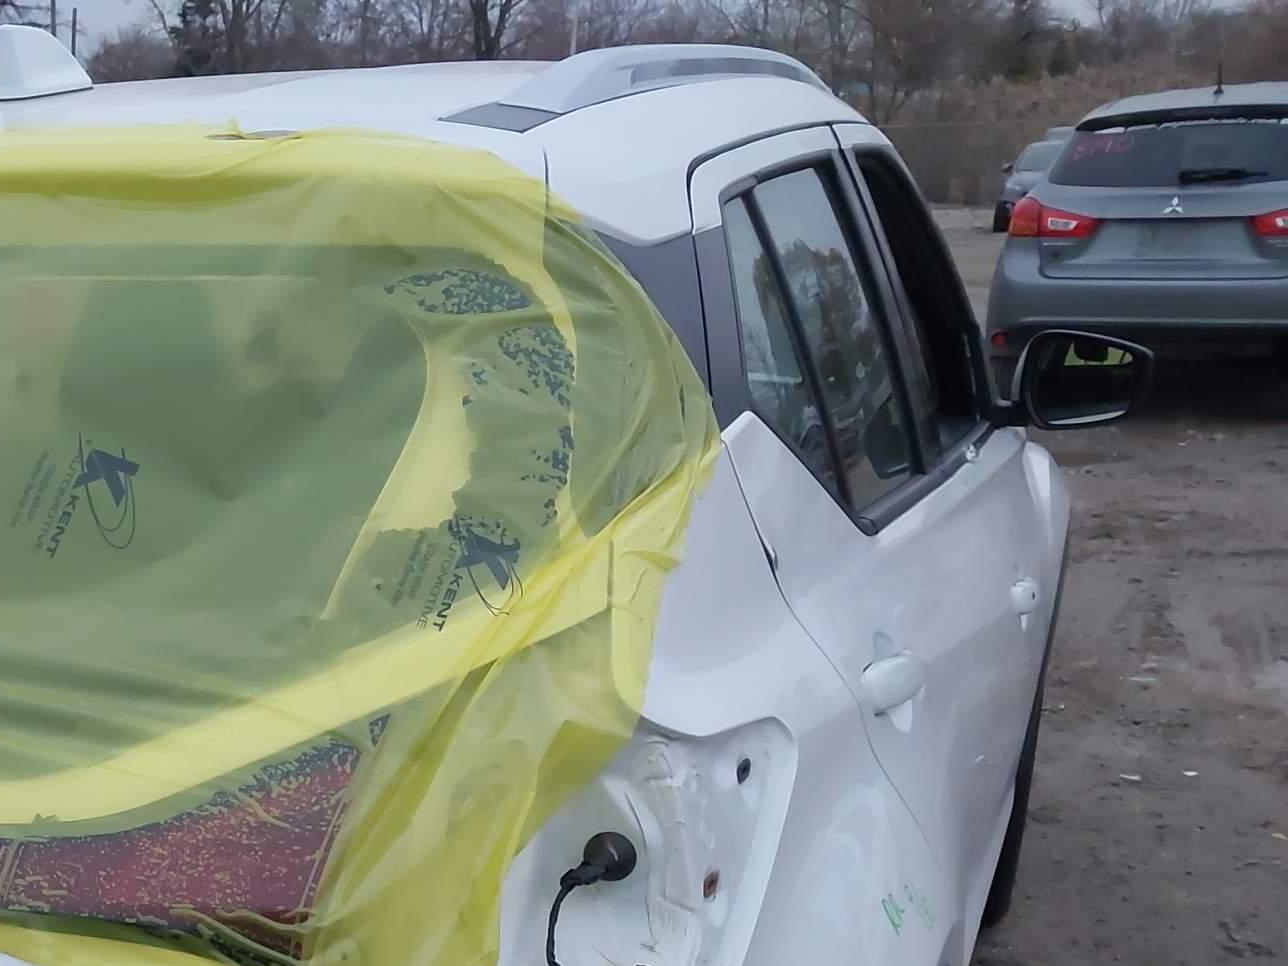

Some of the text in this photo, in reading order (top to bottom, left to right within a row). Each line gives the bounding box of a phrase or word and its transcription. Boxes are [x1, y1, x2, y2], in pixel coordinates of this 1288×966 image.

[45, 494, 80, 559] KENT
[416, 539, 460, 630] UTOMOTIVE
[433, 573, 463, 632] KENT
